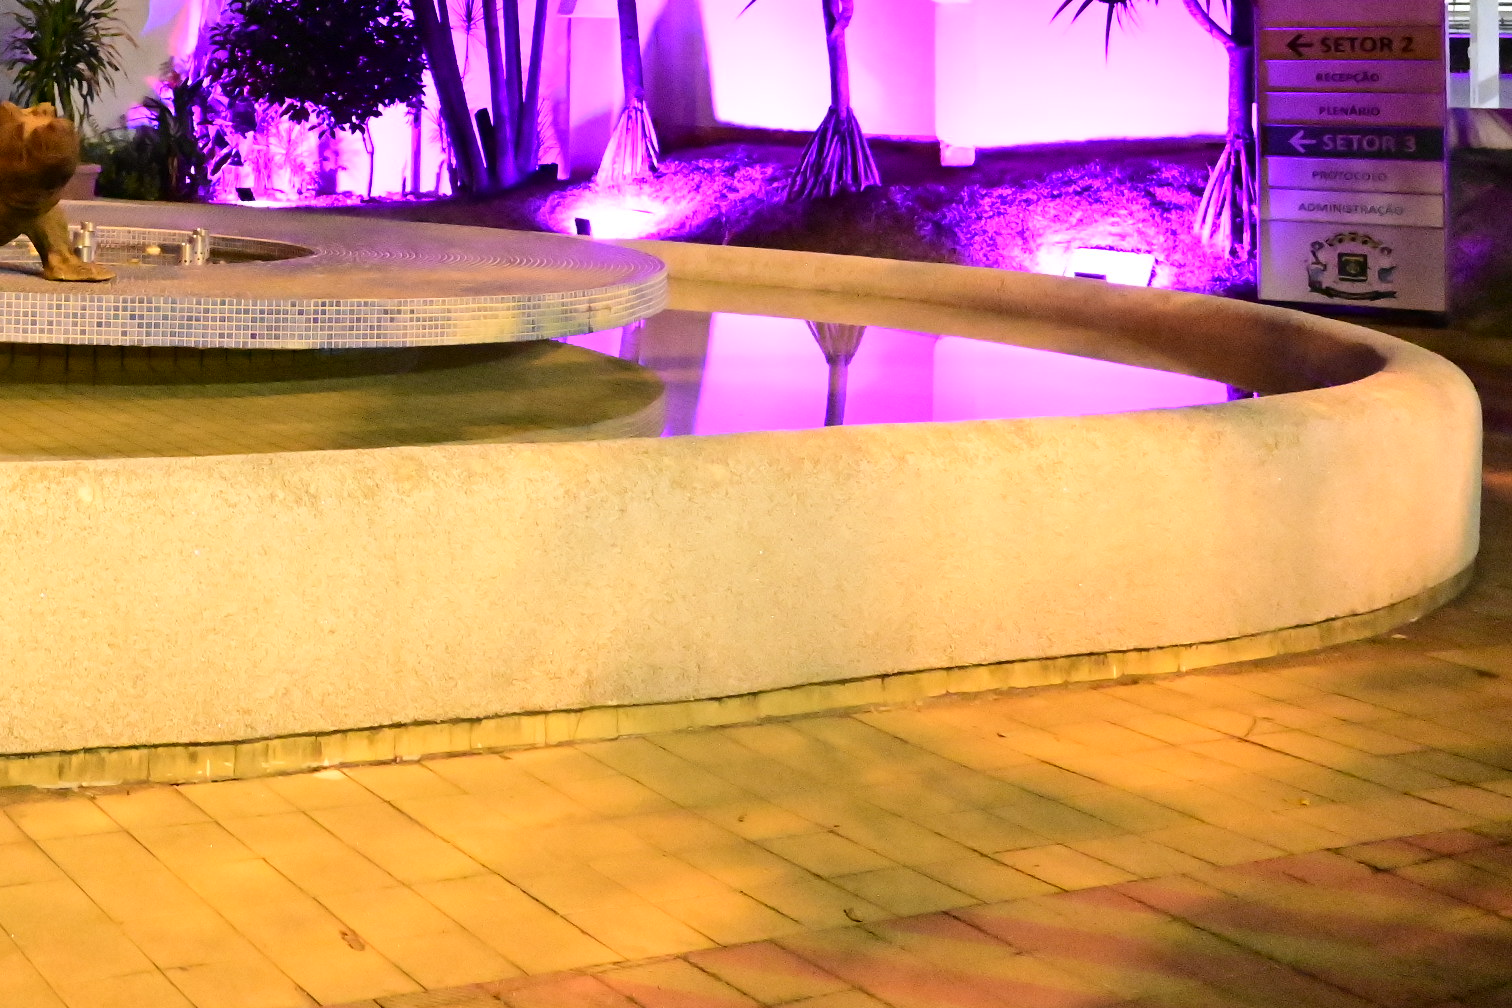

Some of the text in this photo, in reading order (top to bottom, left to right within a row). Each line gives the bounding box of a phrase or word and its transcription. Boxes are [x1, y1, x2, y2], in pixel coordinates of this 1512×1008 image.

[1320, 35, 1414, 54] SETOR 2
[1315, 70, 1380, 84] RECEPÇÃO
[1319, 103, 1381, 117] PLENÁRIO
[1322, 134, 1417, 153] SETOR 3
[1311, 170, 1388, 182] PROTOCOLO
[1298, 202, 1404, 218] ADMINISTRAÇÃO
